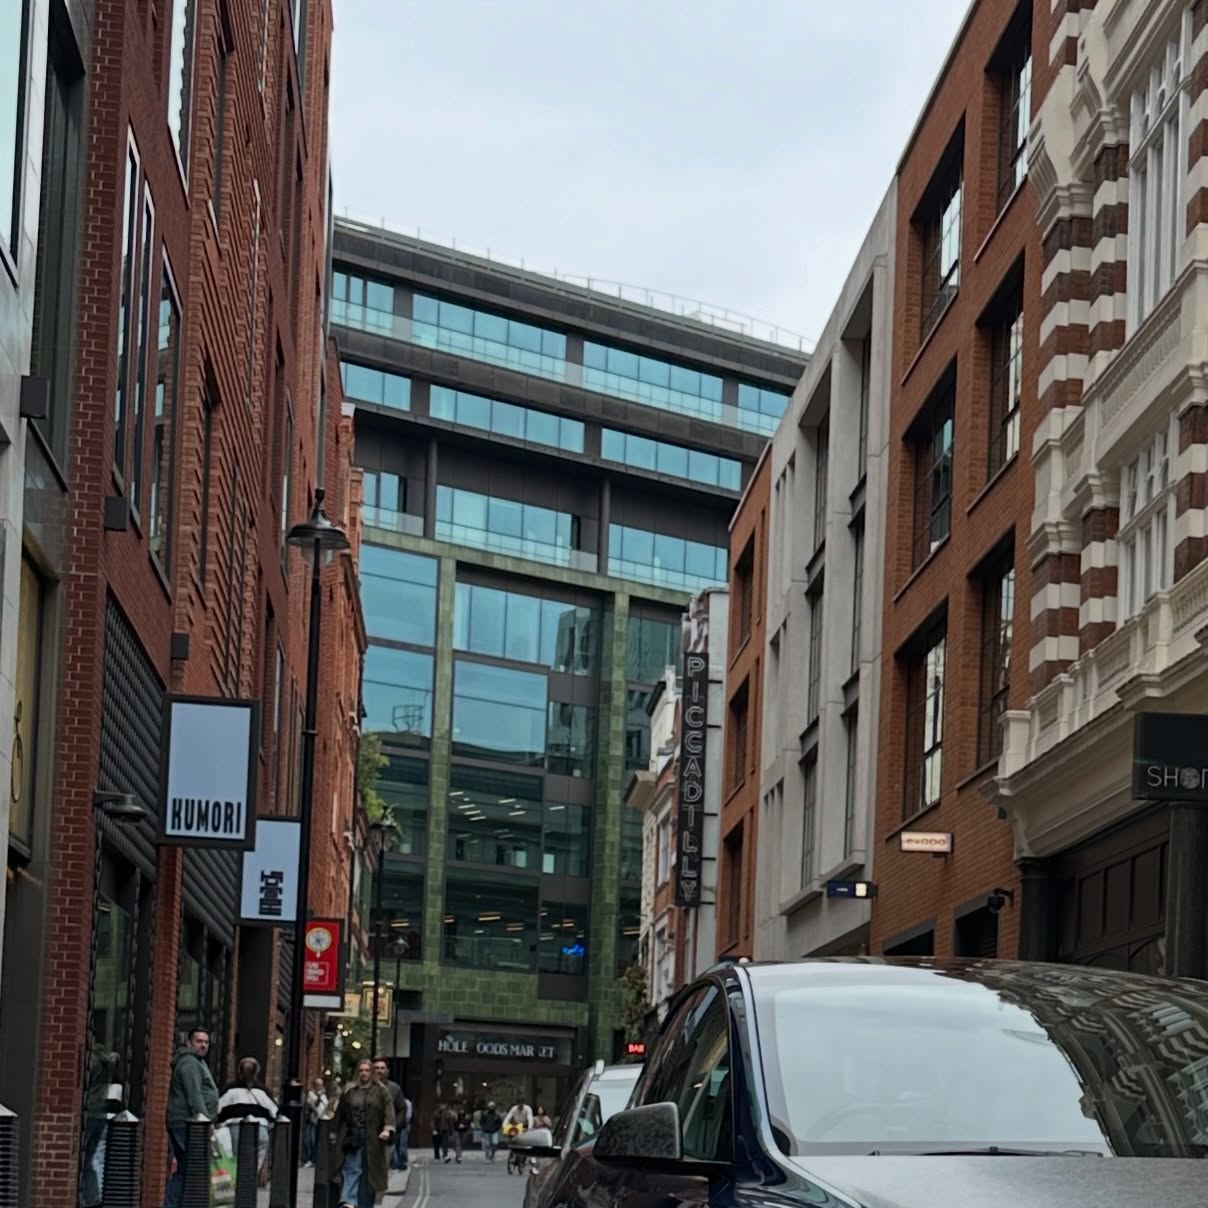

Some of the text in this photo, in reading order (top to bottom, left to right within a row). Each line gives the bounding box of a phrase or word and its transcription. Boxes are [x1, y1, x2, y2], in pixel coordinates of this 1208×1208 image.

[680, 656, 705, 900] PICCADILLY
[170, 797, 242, 835] KUMORI
[437, 1038, 556, 1059] HOLE OODS MARET
